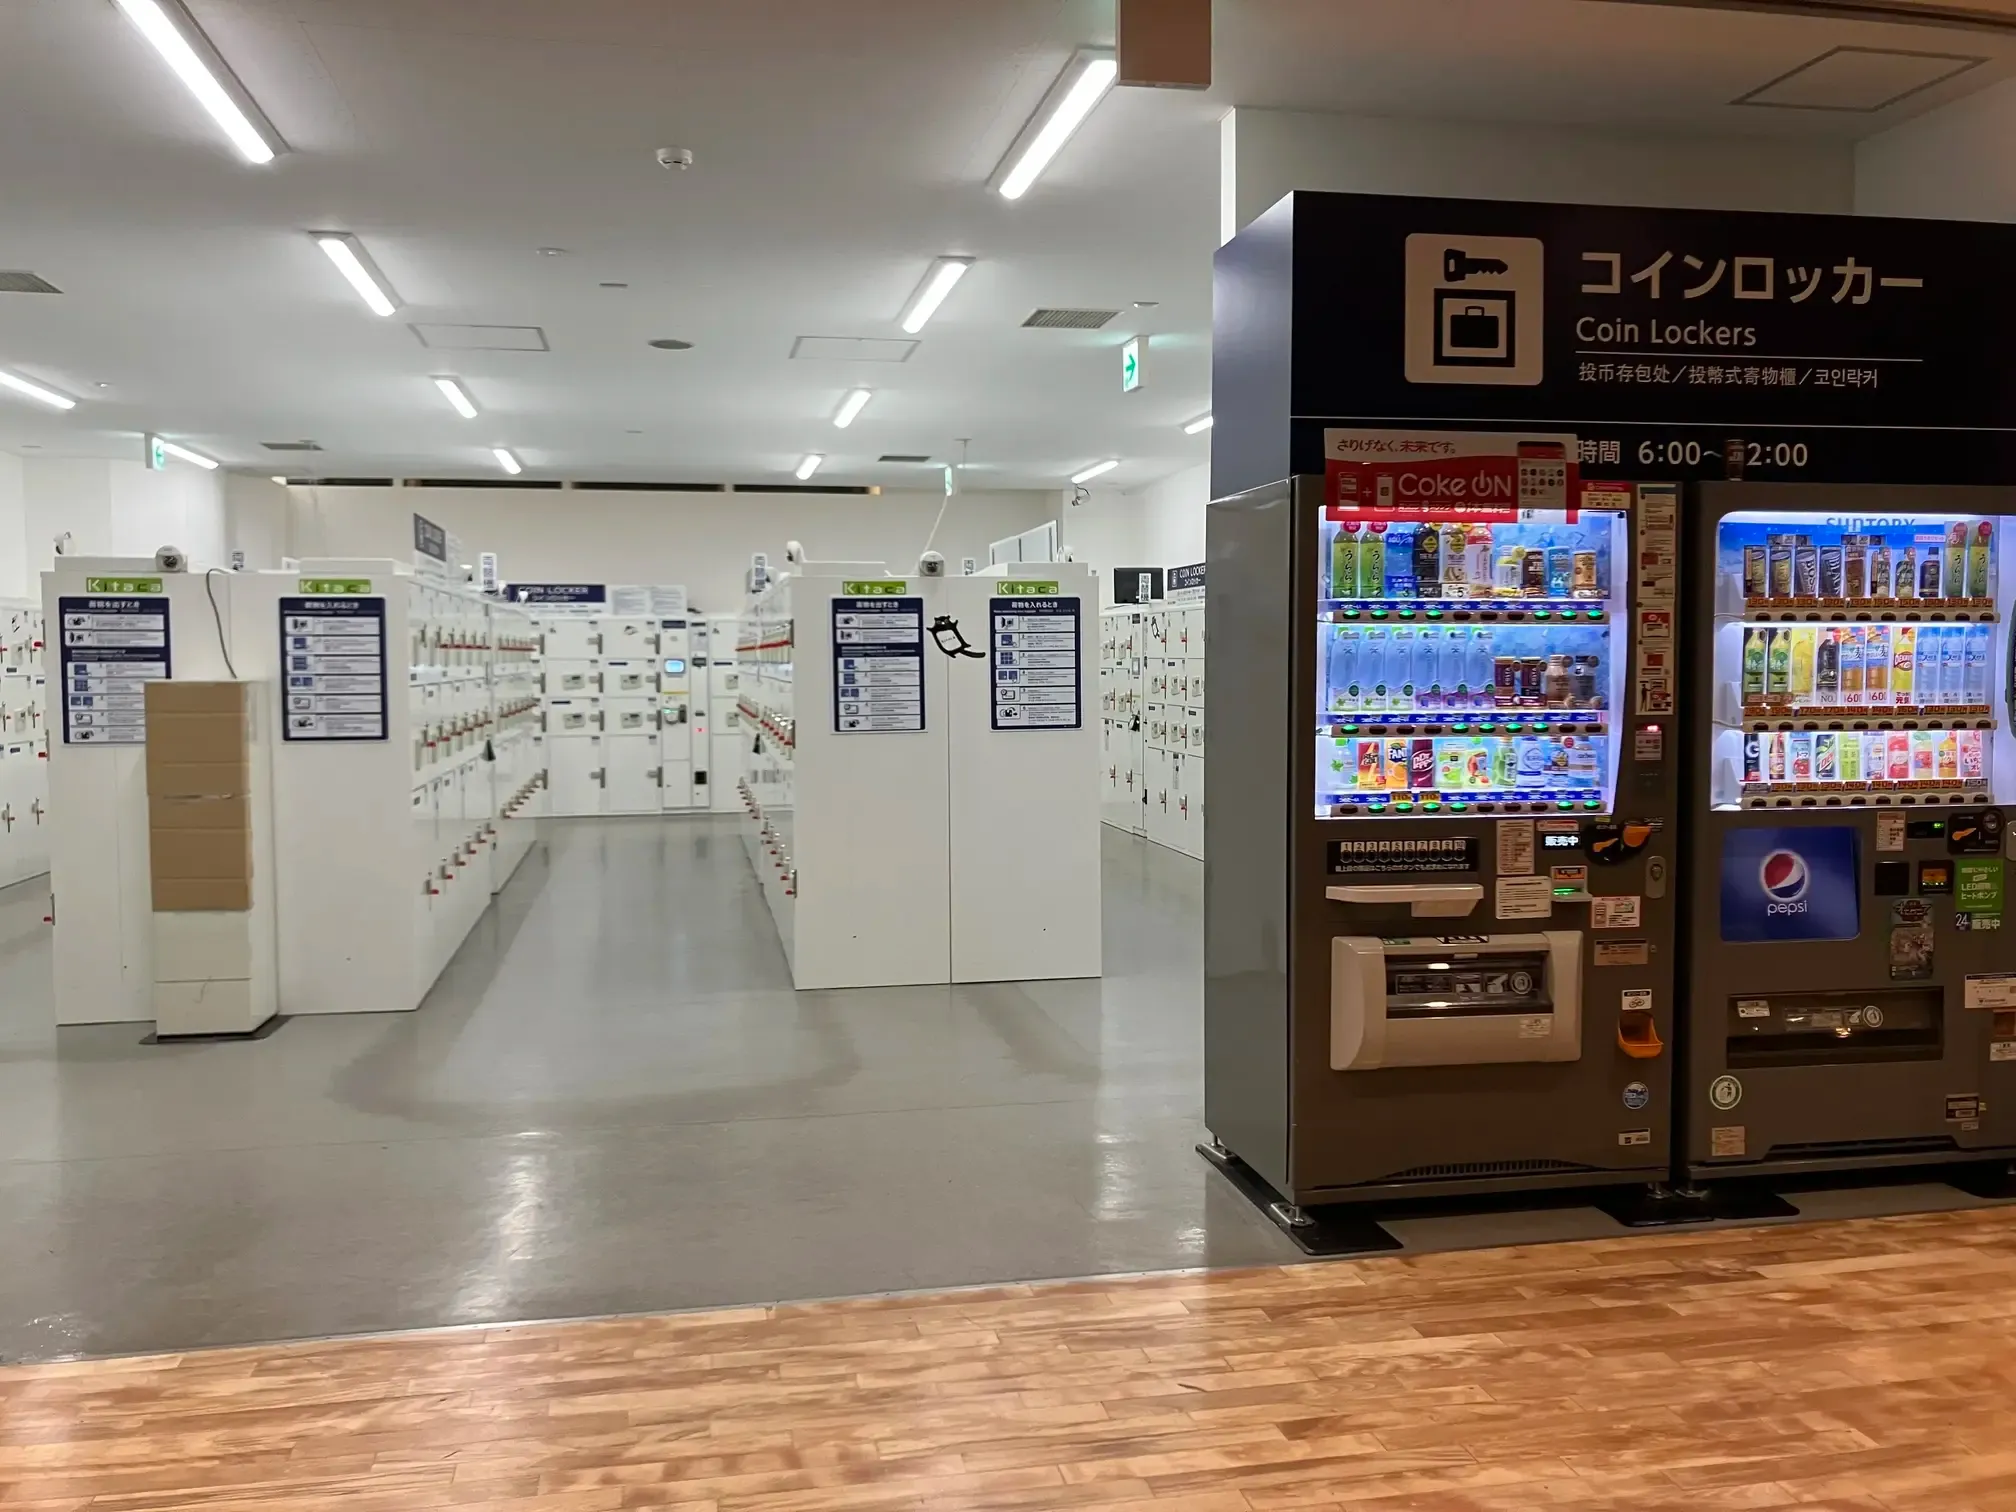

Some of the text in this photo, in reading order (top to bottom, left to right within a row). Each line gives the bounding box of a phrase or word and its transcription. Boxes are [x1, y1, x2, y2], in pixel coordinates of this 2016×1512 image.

[1581, 249, 1924, 305] コインロッカー
[1575, 315, 1758, 348] Coin Lockers
[1399, 472, 1467, 497] Coke
[843, 582, 906, 594] Kitaca
[998, 581, 1058, 594] Kitaca
[1011, 601, 1058, 609] 荷物を入れるとき
[1544, 835, 1579, 847] 販売中
[1766, 899, 1808, 917] pepsi
[1955, 913, 1970, 927] 24
